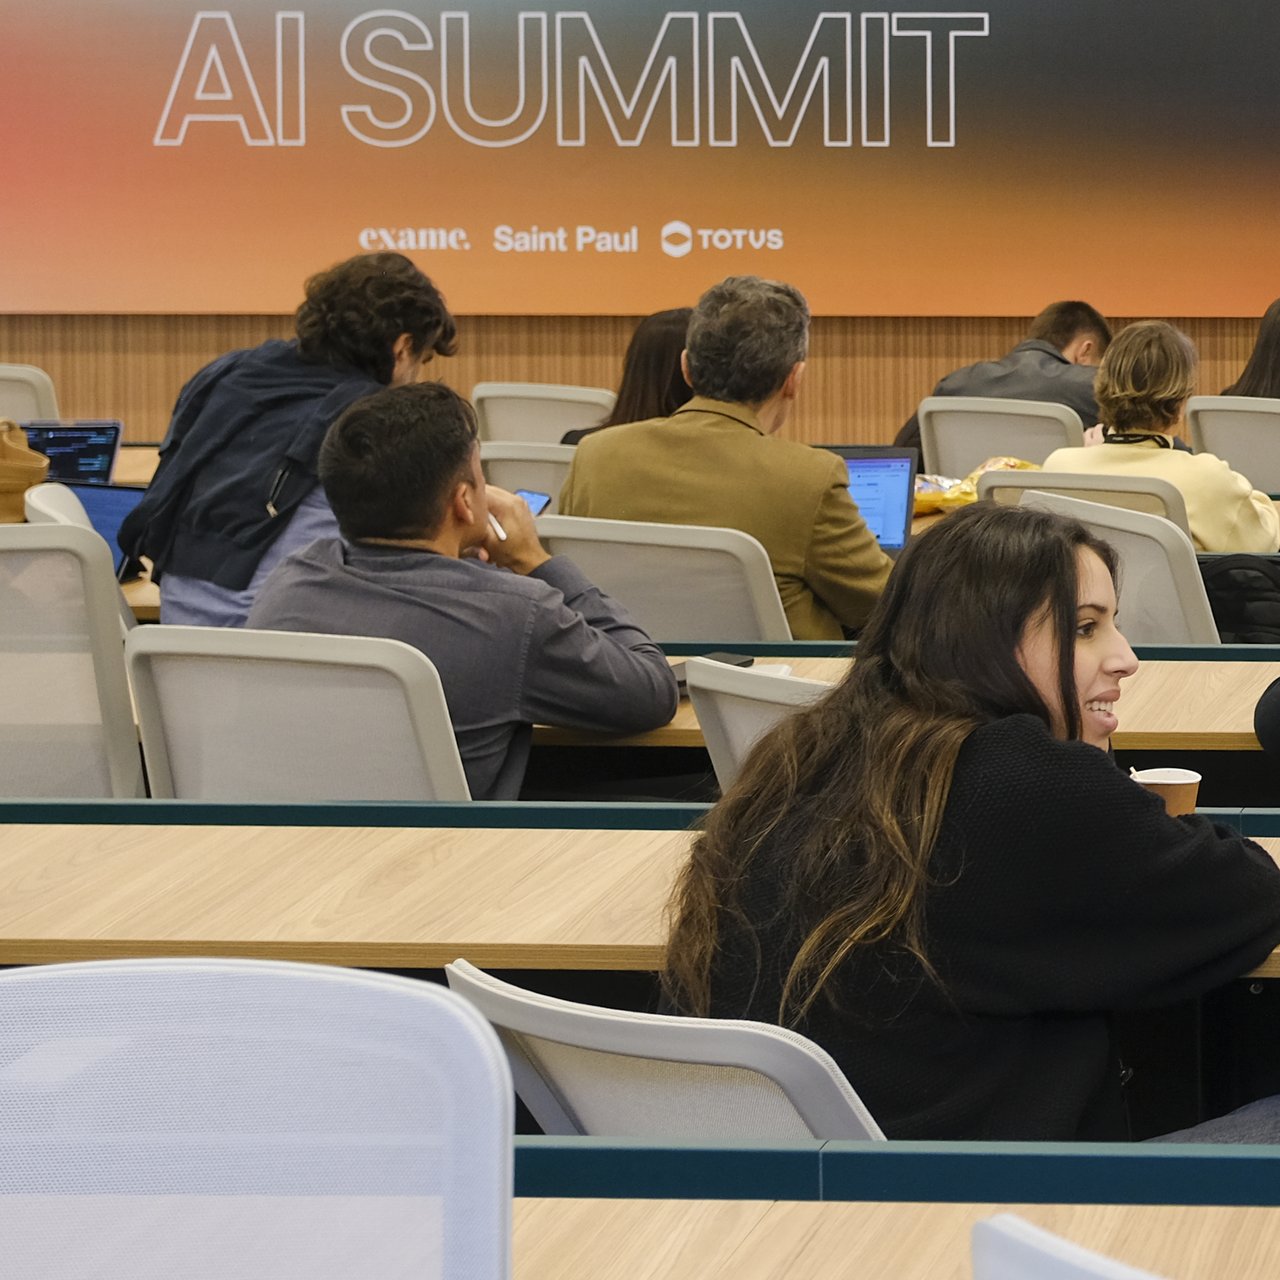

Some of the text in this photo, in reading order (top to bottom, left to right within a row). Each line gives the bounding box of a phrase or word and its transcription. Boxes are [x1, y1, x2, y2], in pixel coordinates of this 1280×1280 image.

[153, 9, 990, 149] AI SUMMIT
[358, 224, 784, 253] exame. Saint Paul TOTVS
